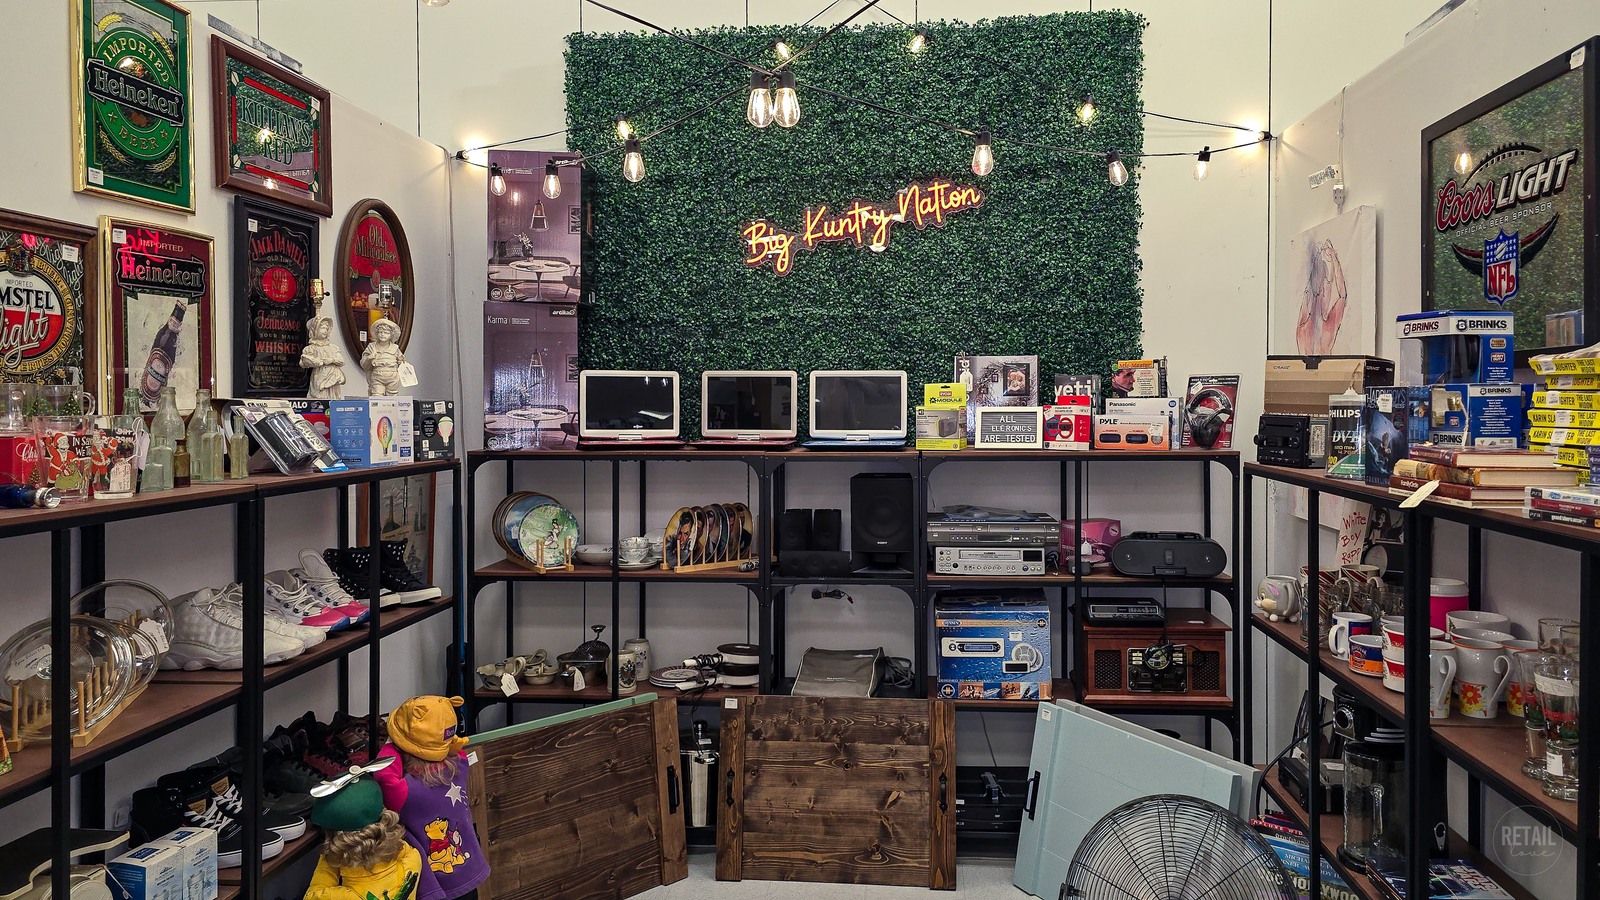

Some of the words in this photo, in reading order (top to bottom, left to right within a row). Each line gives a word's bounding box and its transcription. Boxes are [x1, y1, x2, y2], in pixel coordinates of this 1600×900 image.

[103, 37, 171, 83] IMPORTED
[93, 67, 180, 118] Heineken
[118, 126, 160, 150] BEER
[261, 137, 294, 167] RED
[1436, 180, 1496, 232] Coors
[1496, 149, 1579, 209] LIGHT
[743, 222, 794, 272] Big
[803, 202, 893, 248] Kuntry
[899, 182, 981, 225] Nation
[1456, 224, 1487, 237] OFFICIAL
[1489, 215, 1509, 228] BEER
[1512, 202, 1552, 221] SPONSOR
[140, 238, 184, 252] IMPORTED
[369, 223, 385, 248] Old
[251, 235, 274, 261] JACK
[354, 234, 397, 263] Milwaukee
[121, 255, 202, 287] Heineken
[1487, 262, 1516, 299] NFL
[5, 278, 34, 288] IMPORTED
[0, 286, 54, 310] MSTEL
[256, 309, 301, 332] Tennessee
[487, 315, 508, 325] Karma
[1411, 321, 1440, 332] BRINKS
[1468, 320, 1508, 329] BRINKS
[254, 340, 304, 355] WHISKEY
[1054, 380, 1093, 403] yeti
[999, 415, 1017, 423] ALL
[1329, 409, 1361, 418] PHILIPS
[984, 434, 1001, 443] ARE
[1005, 434, 1036, 443] TESTED
[1439, 434, 1463, 443] BRINKS
[1342, 512, 1367, 530] White
[1340, 530, 1362, 548] Boy
